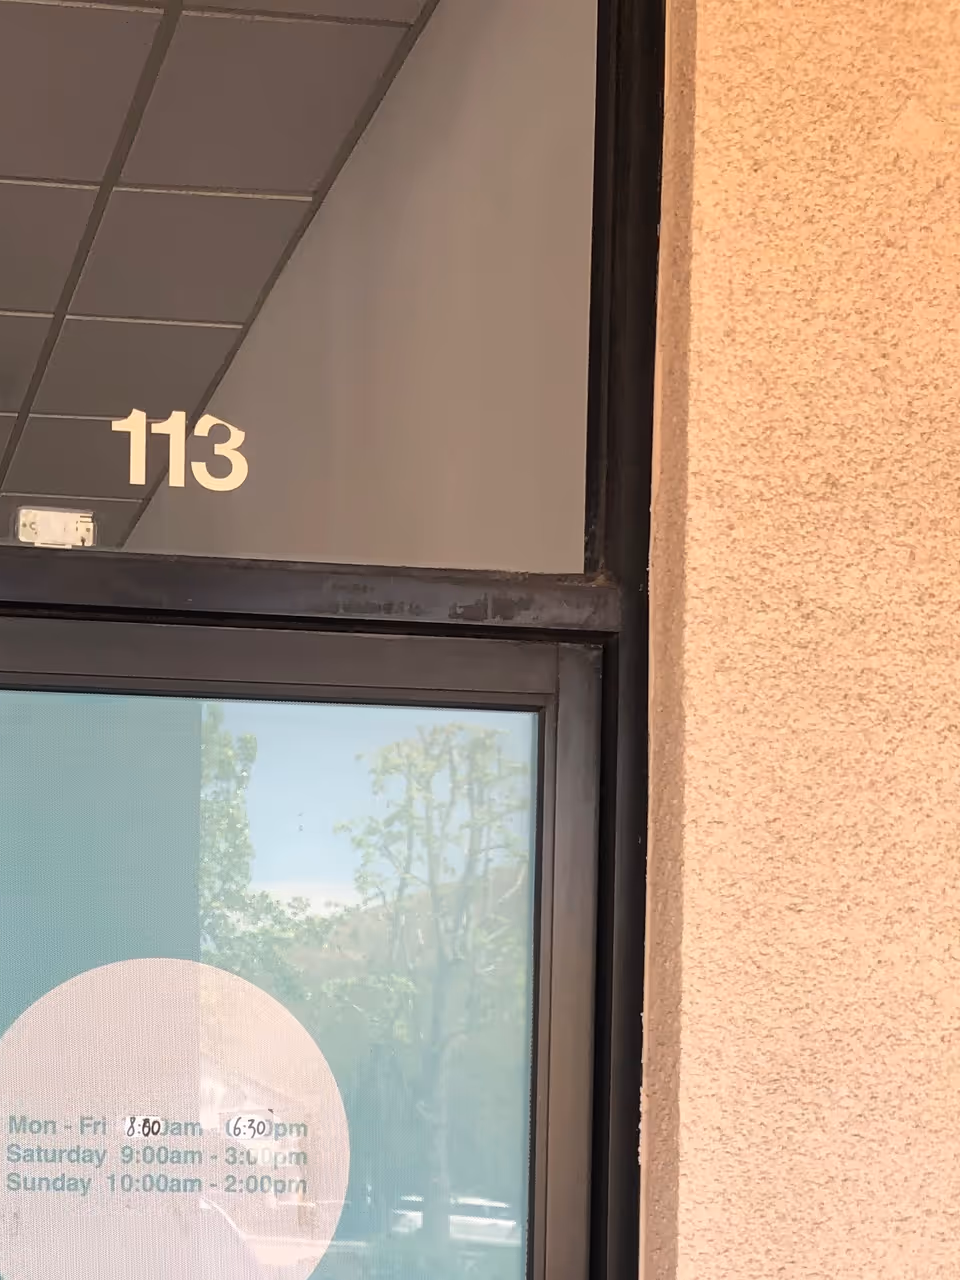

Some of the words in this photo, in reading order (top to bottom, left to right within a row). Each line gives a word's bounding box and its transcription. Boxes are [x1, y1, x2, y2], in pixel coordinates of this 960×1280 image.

[111, 408, 249, 492] 113
[8, 1115, 56, 1135] Mon
[80, 1115, 107, 1135] Fri
[7, 1143, 107, 1168] Saturday
[120, 1145, 203, 1164] 9:00am
[7, 1172, 92, 1196] Sunday
[106, 1173, 203, 1193] 10:00am
[225, 1174, 307, 1196] 2:00pm
